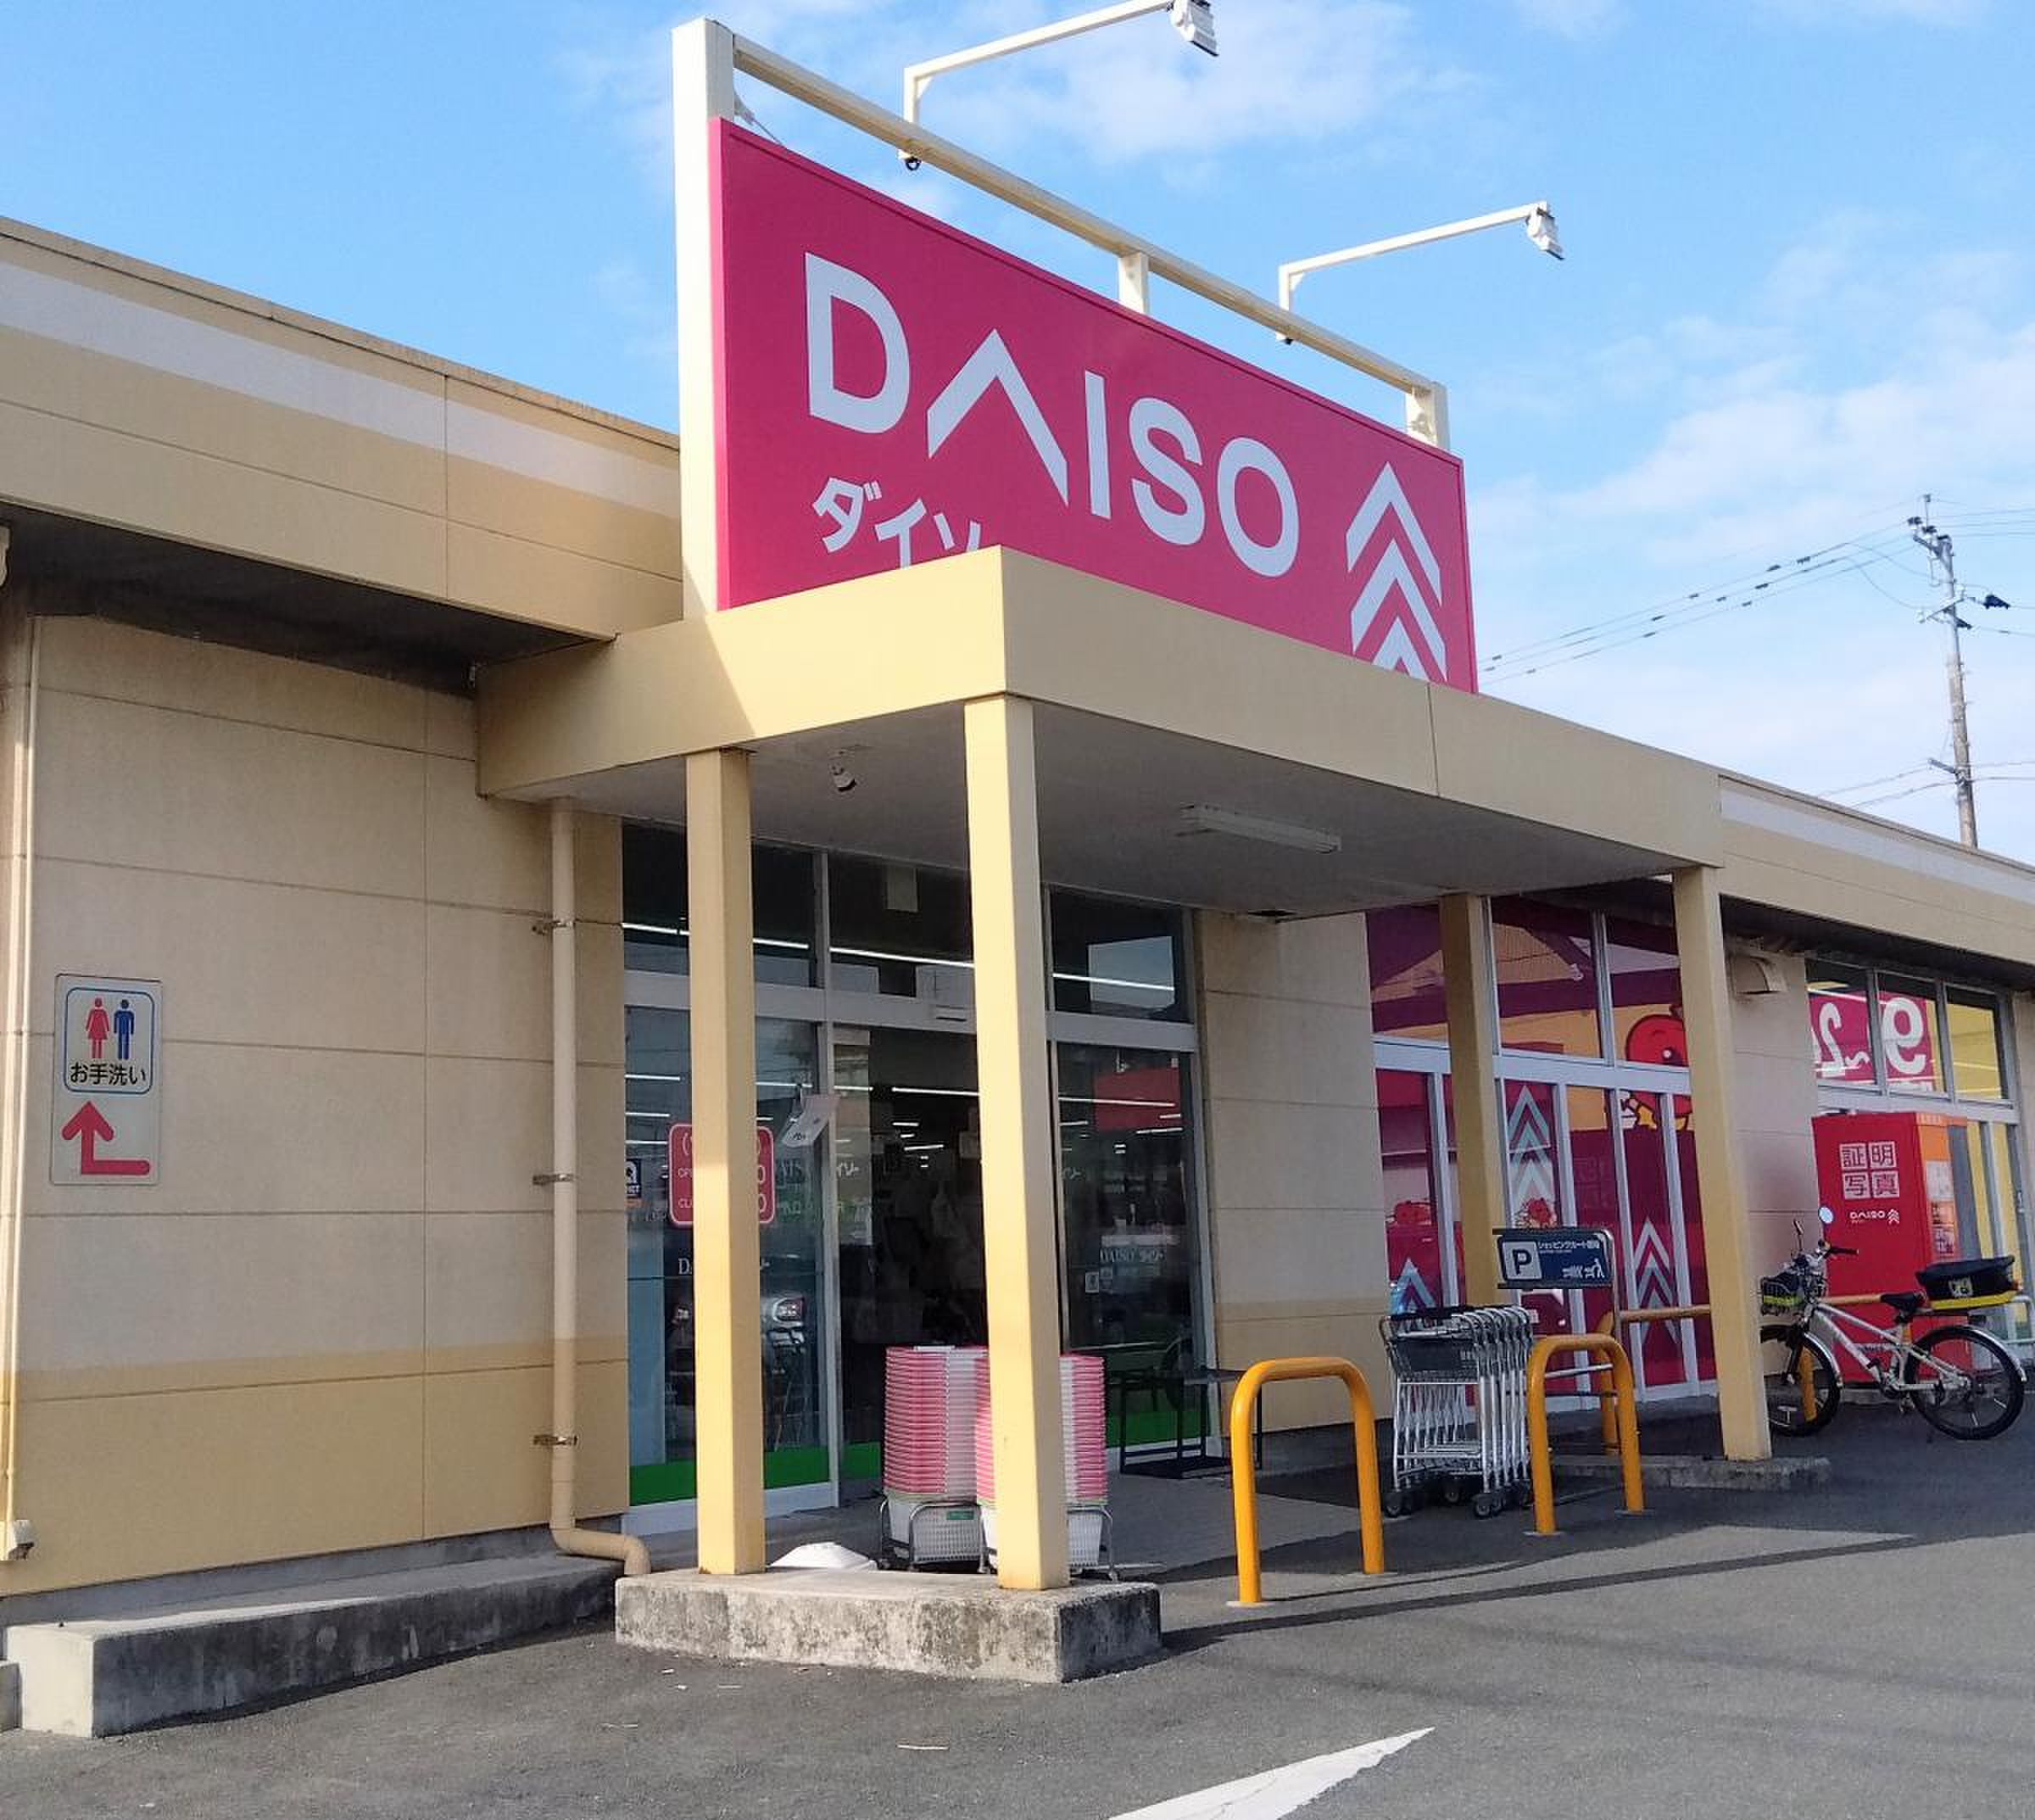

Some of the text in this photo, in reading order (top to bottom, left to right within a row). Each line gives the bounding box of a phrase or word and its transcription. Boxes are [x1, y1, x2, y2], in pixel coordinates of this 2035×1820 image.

[806, 252, 1299, 577] DAISO
[70, 1062, 147, 1086] お手洗い
[1841, 1143, 1894, 1168] 証明
[1849, 1210, 1886, 1220] DAISO
[1513, 1250, 1532, 1275] P
